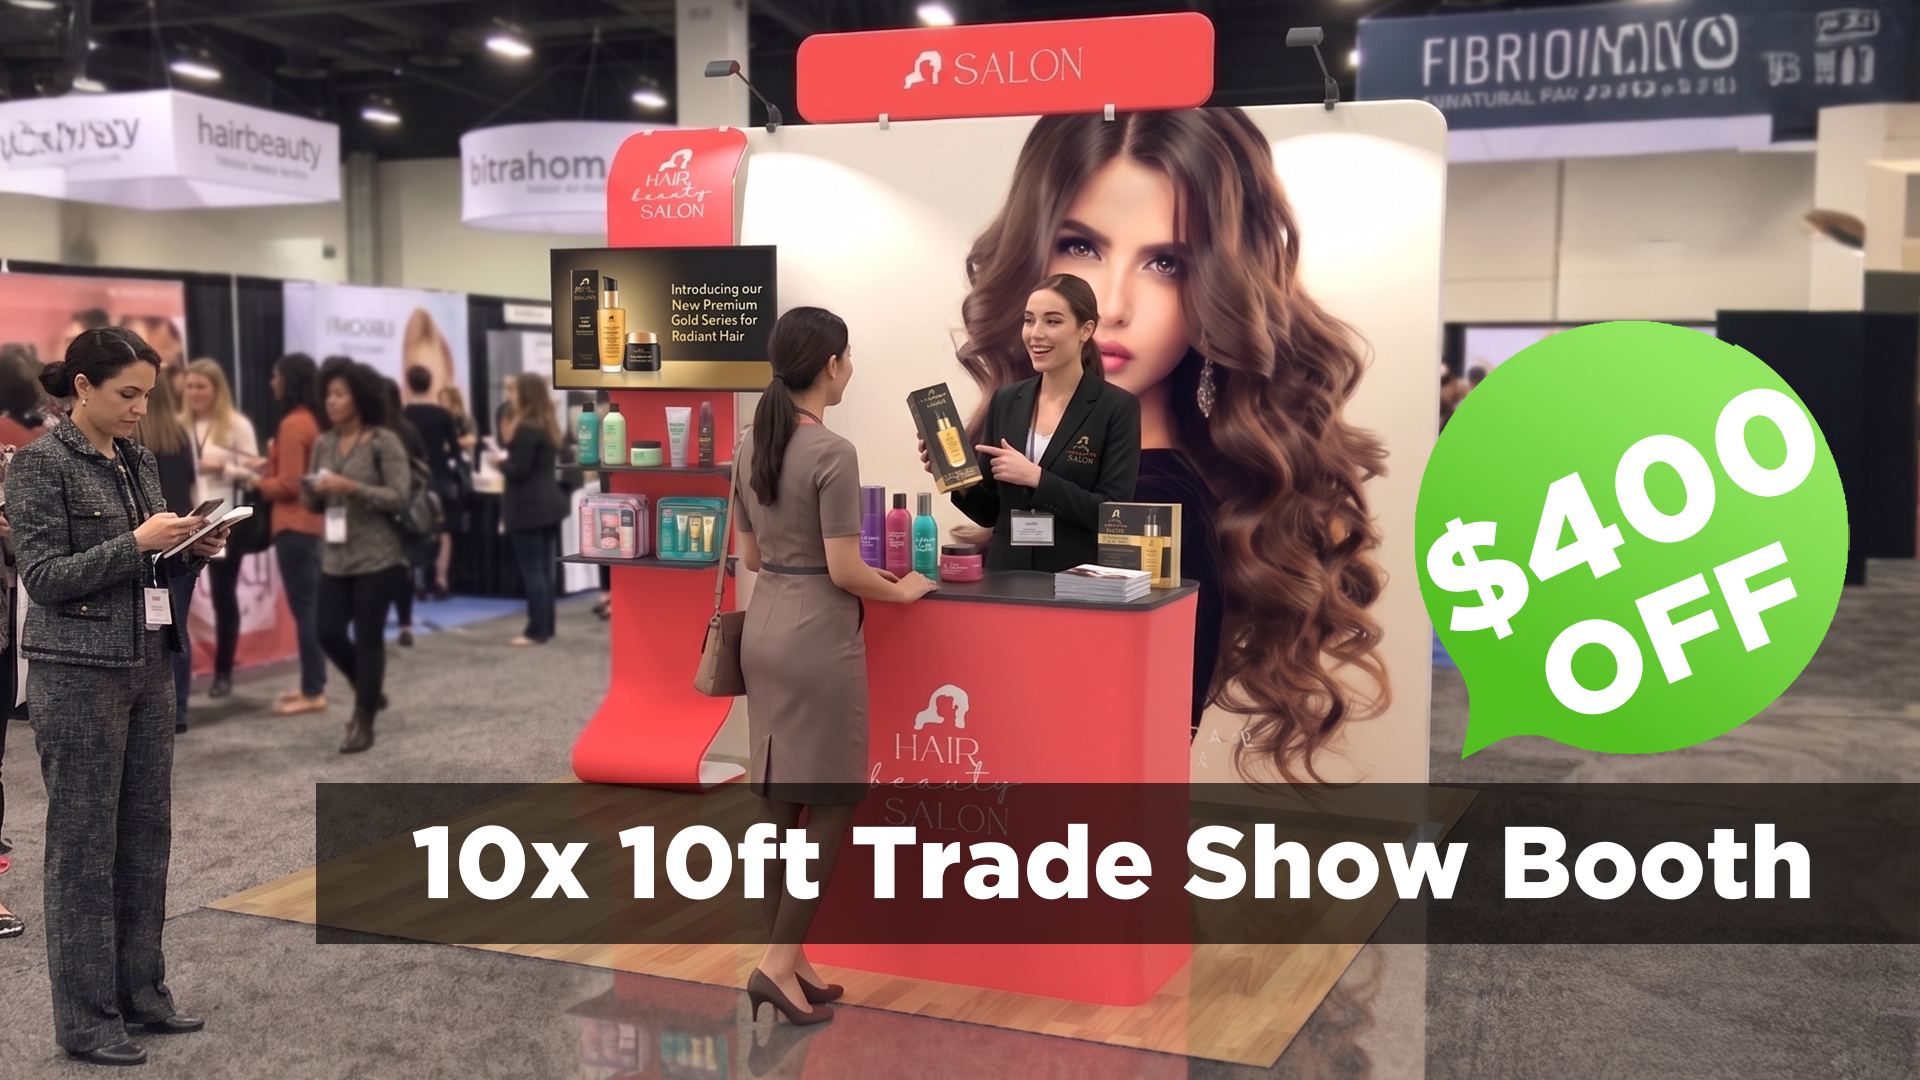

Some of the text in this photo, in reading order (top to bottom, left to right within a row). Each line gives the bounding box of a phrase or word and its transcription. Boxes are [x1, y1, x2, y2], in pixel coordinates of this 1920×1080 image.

[953, 46, 1083, 86] SALON
[197, 112, 322, 171] hairbeauty
[645, 170, 691, 187] HAIR
[630, 181, 712, 203] beauty
[640, 202, 704, 220] SALON
[671, 283, 763, 298] Introducing our
[672, 299, 758, 311] New Premium
[671, 313, 758, 326] Gold Series for
[672, 330, 745, 342] Radiant Hair
[1067, 454, 1094, 465] SALON
[895, 732, 980, 767] HAIR
[869, 760, 1023, 805] beauty
[883, 797, 1010, 837] SALON
